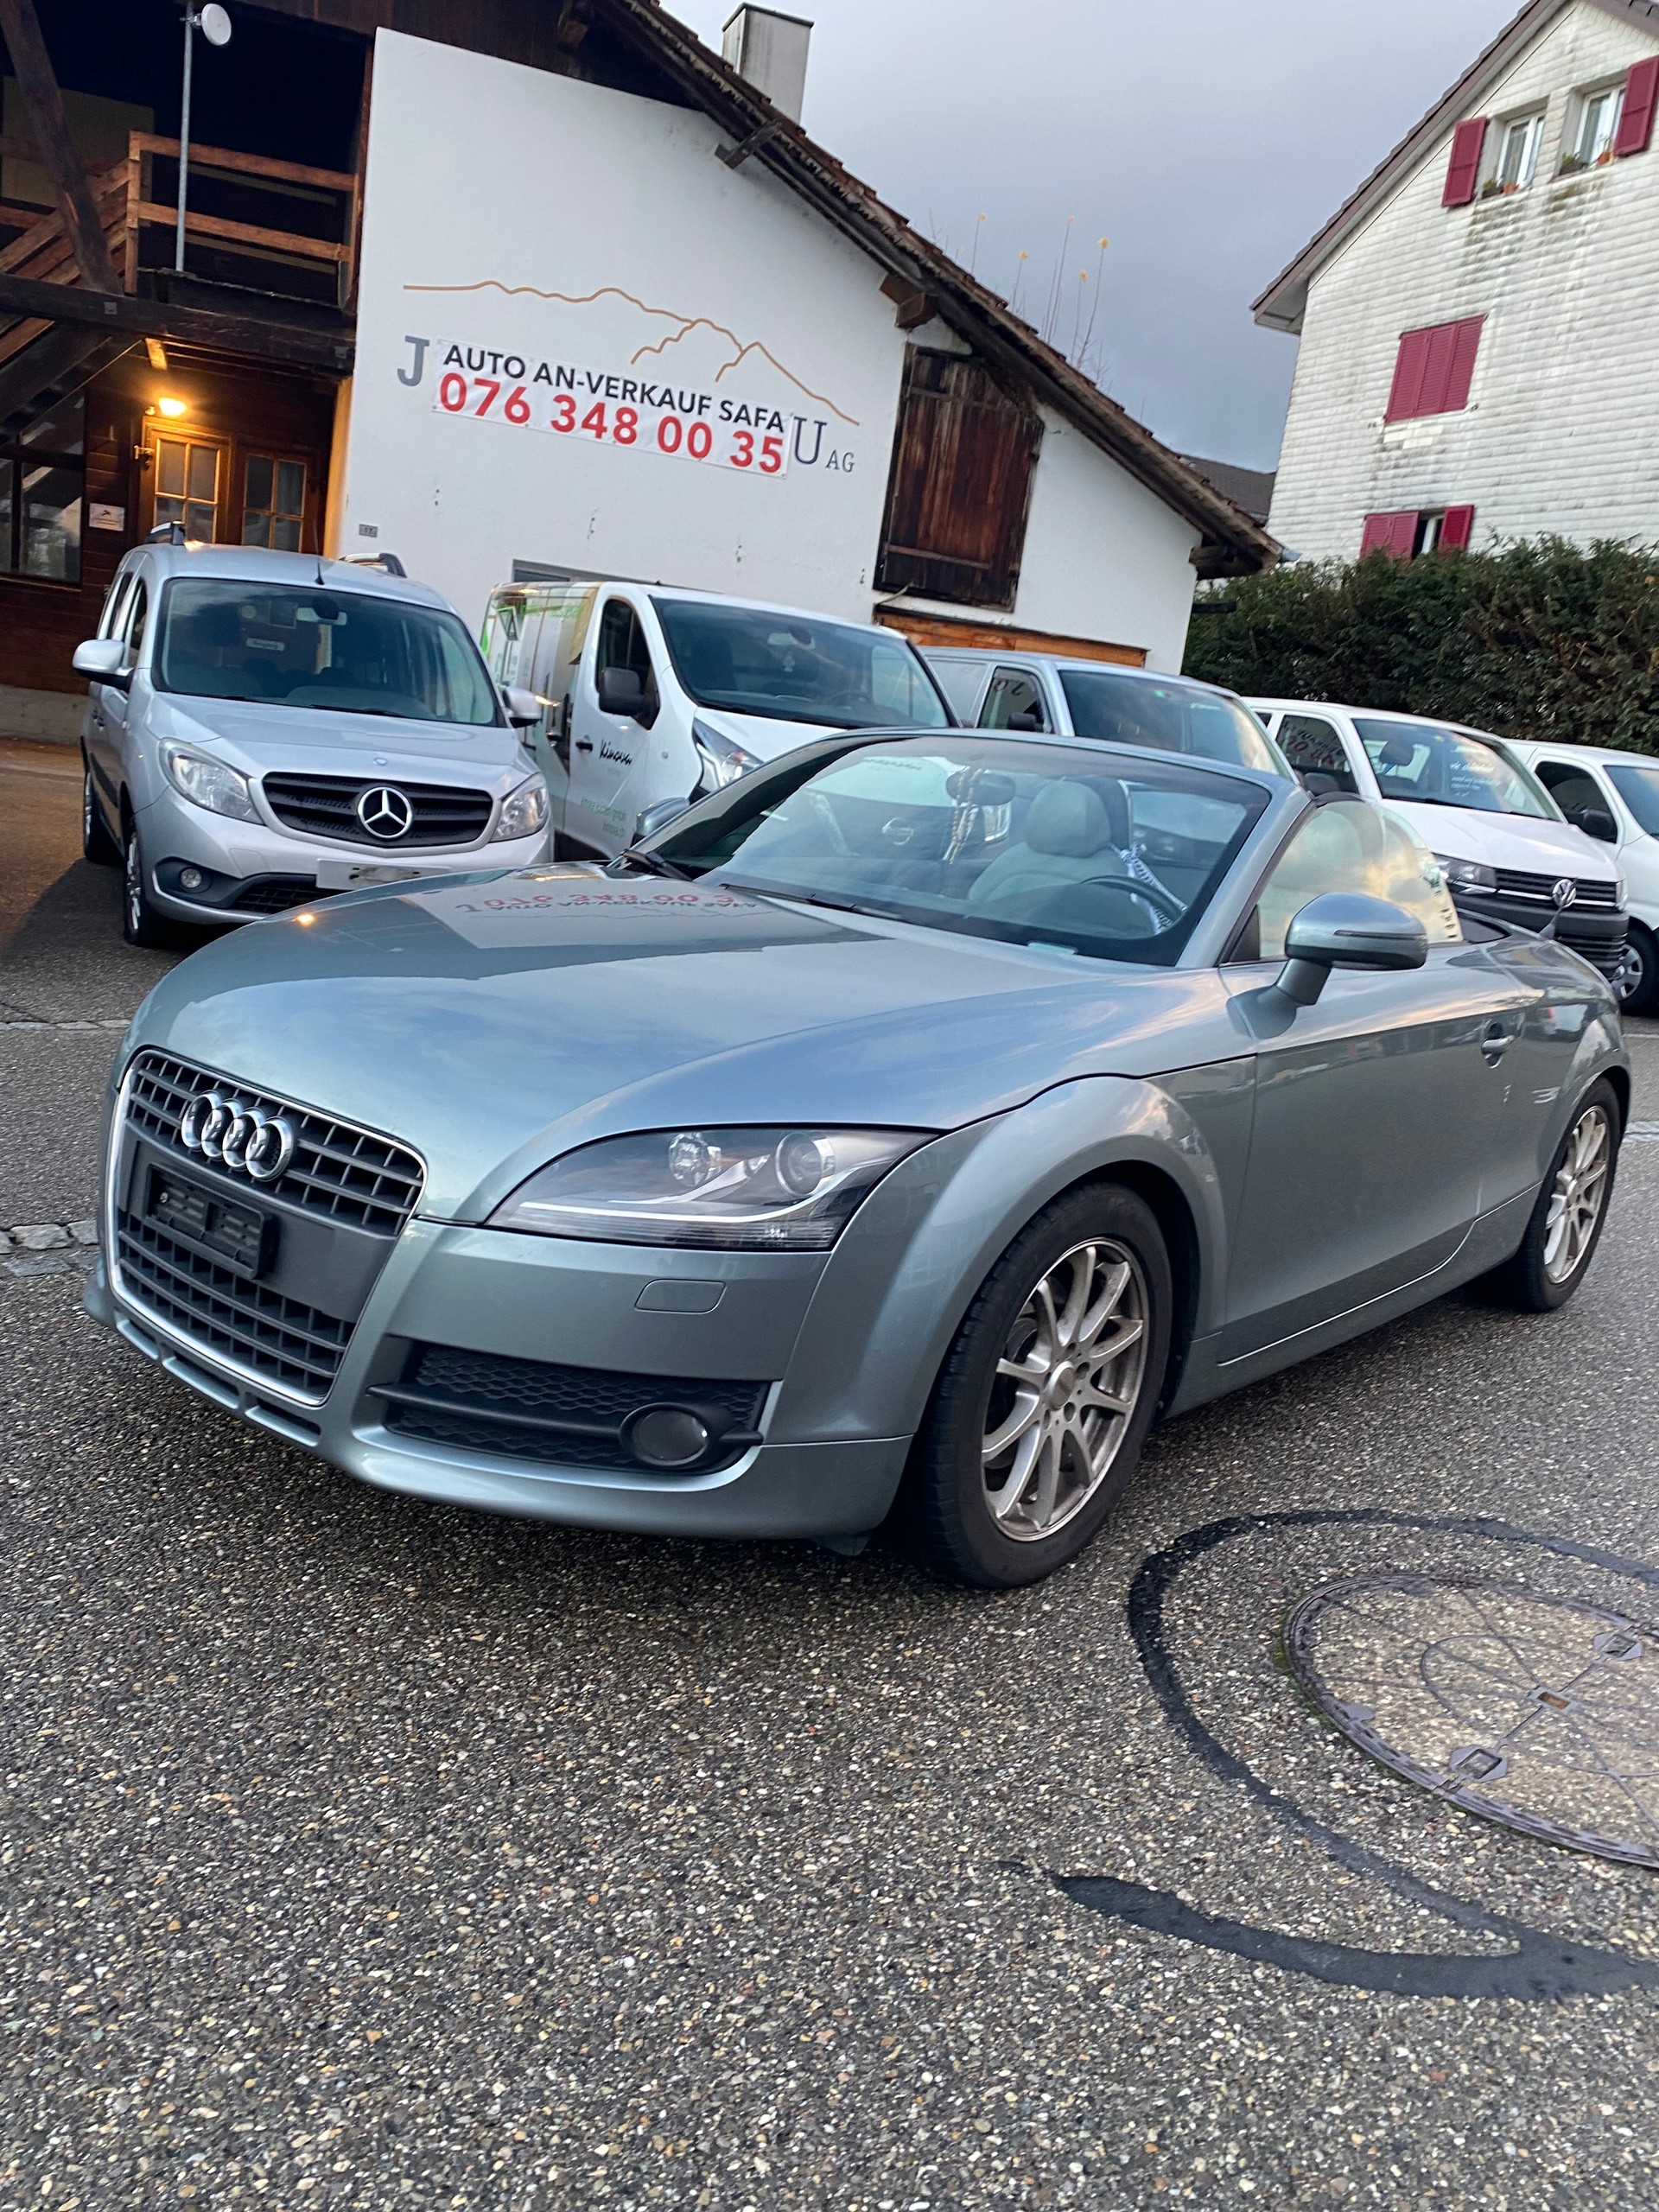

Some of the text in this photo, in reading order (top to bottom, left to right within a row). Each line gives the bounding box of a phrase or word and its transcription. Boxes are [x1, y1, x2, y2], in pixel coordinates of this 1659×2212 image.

[397, 334, 430, 386] J
[442, 345, 785, 433] AUTO AN-VERKAUF SAFA
[439, 372, 784, 473] 076 348 00 35
[793, 415, 856, 473] U AG
